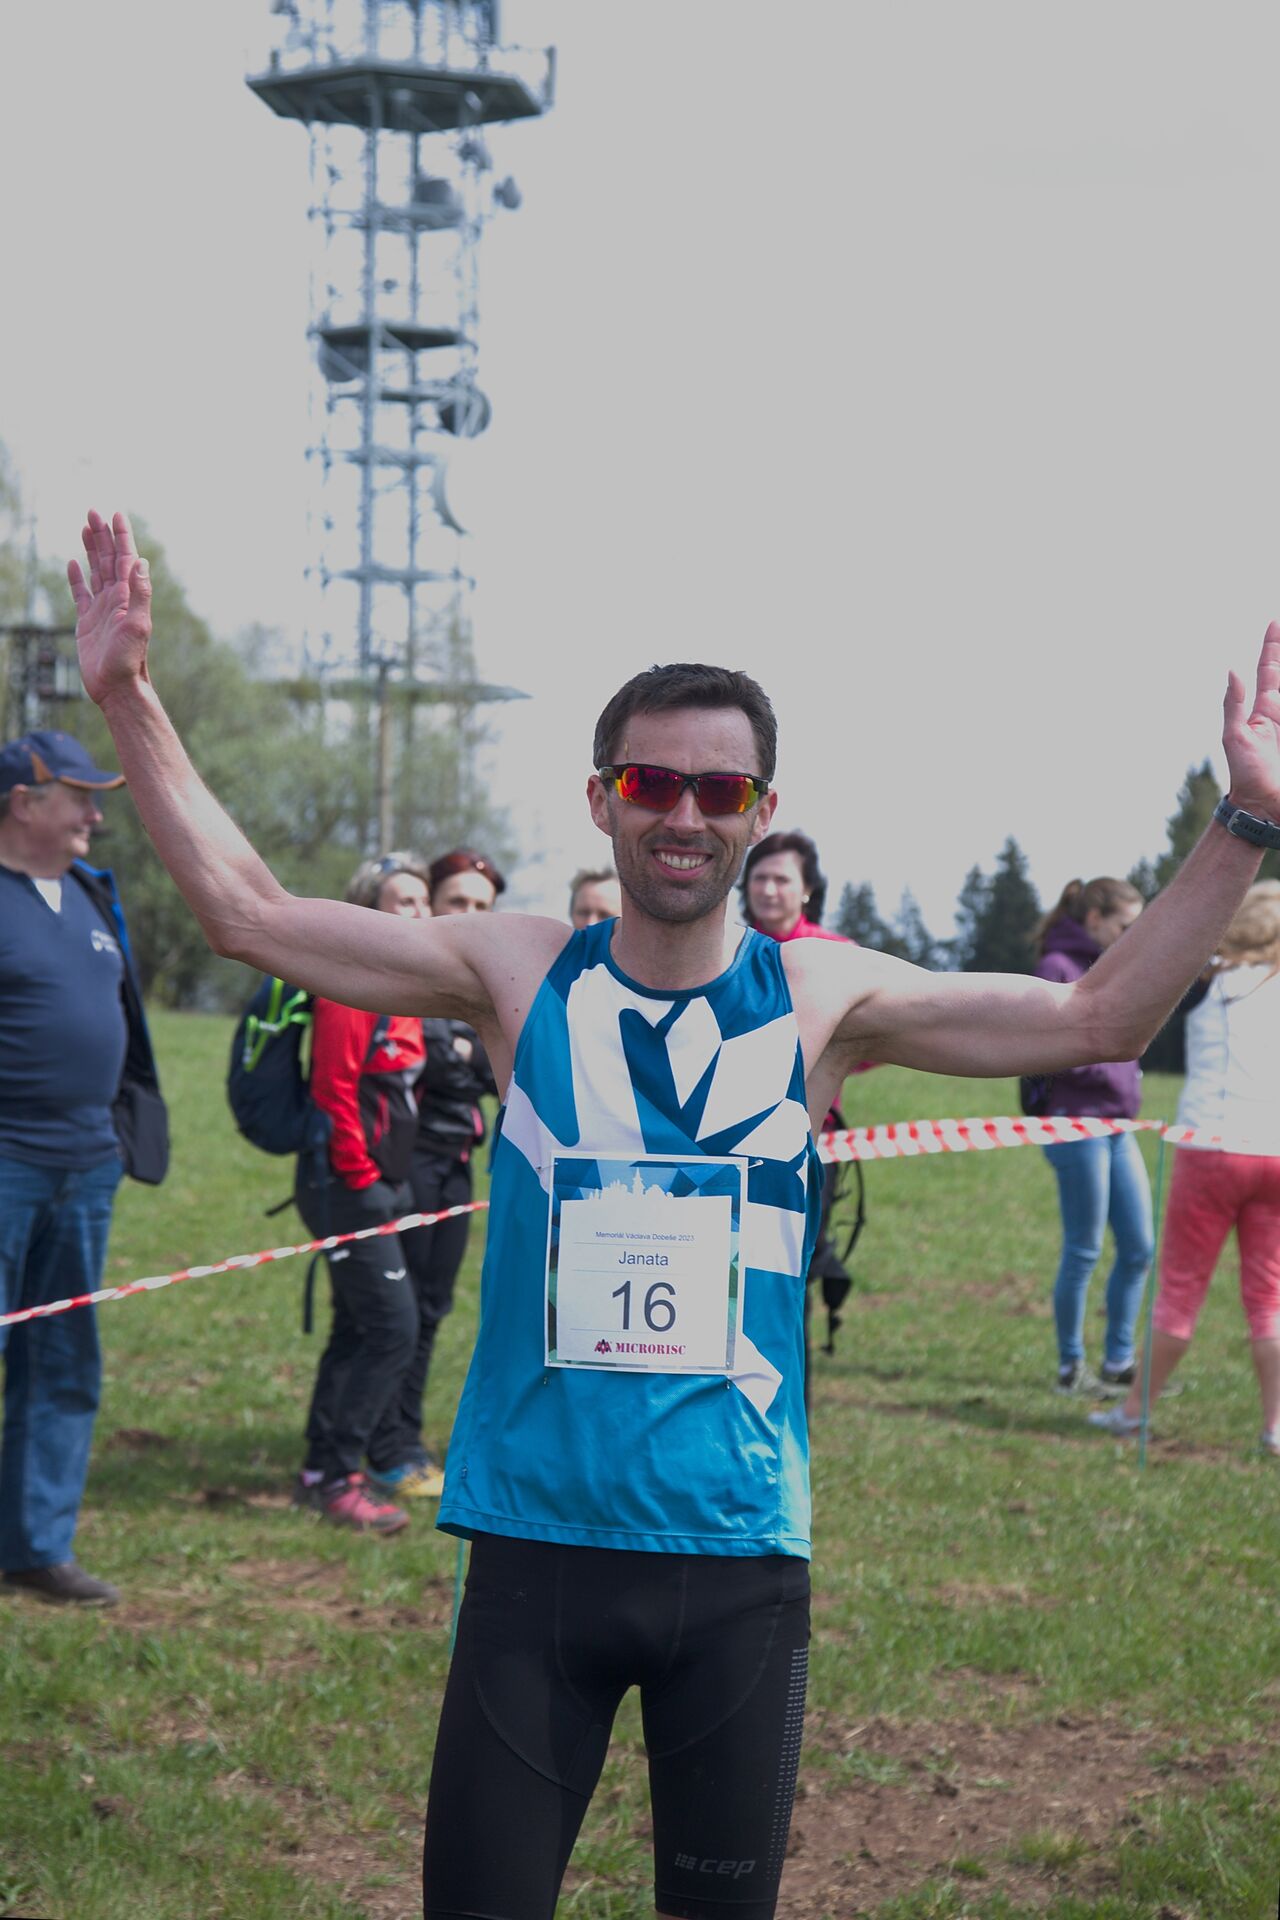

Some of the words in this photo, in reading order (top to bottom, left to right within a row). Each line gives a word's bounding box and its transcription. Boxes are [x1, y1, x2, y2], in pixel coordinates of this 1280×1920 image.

[618, 1251, 669, 1266] Janata
[612, 1280, 676, 1332] 16
[615, 1342, 686, 1355] MICRORISC
[699, 1859, 756, 1879] cep
